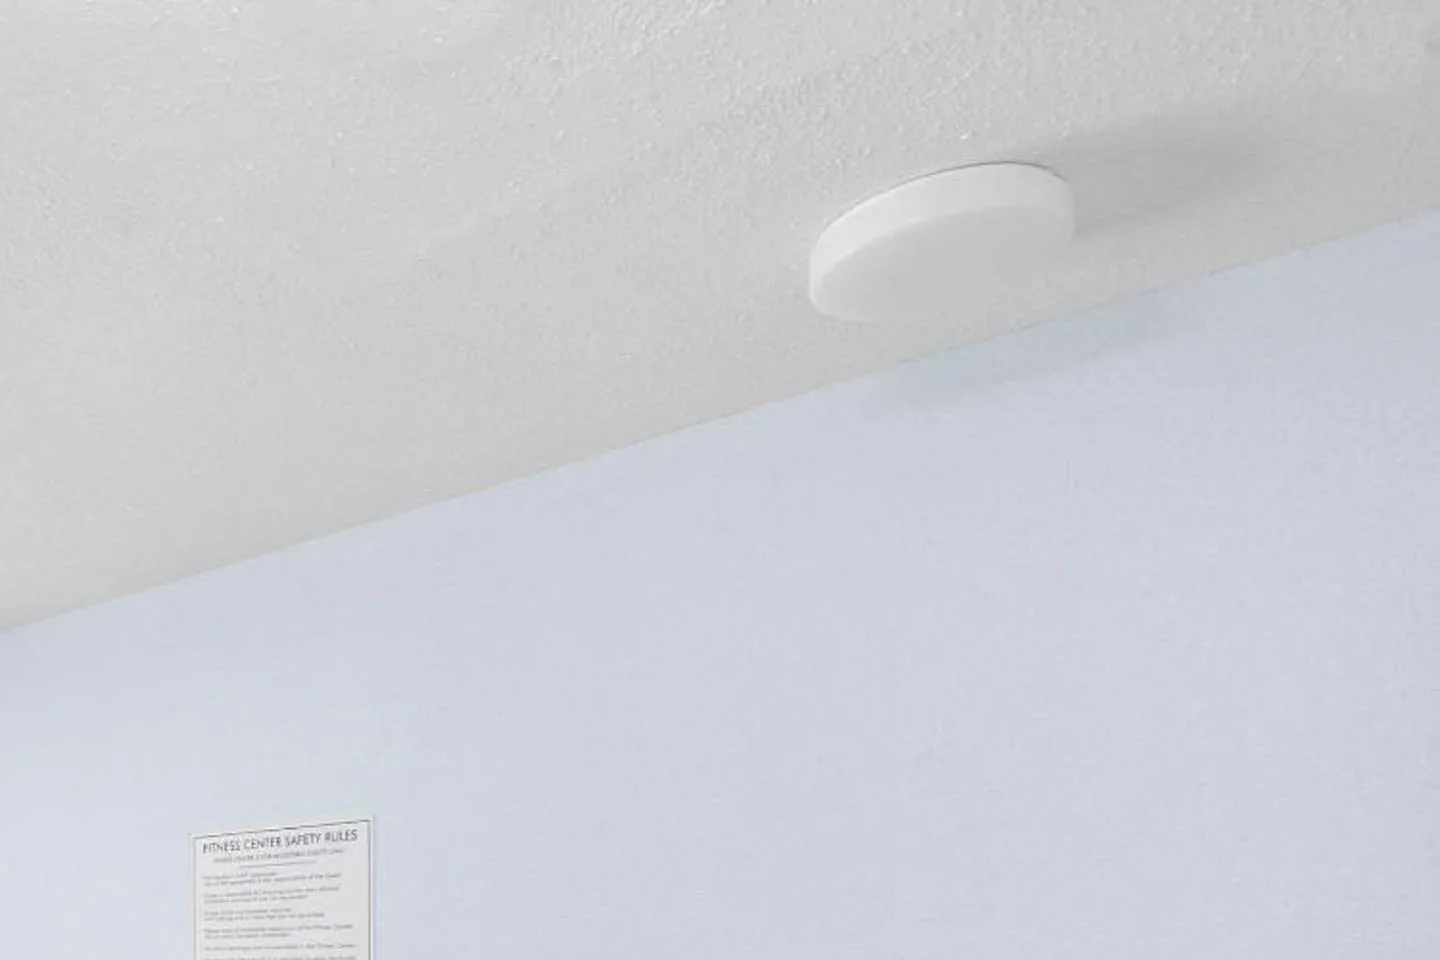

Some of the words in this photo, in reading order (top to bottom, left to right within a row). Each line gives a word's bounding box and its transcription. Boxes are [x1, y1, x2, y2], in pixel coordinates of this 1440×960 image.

[203, 840, 241, 854] FITNESS
[243, 836, 281, 850] CENTER
[284, 832, 322, 847] SAFETY
[324, 828, 358, 842] RULES
